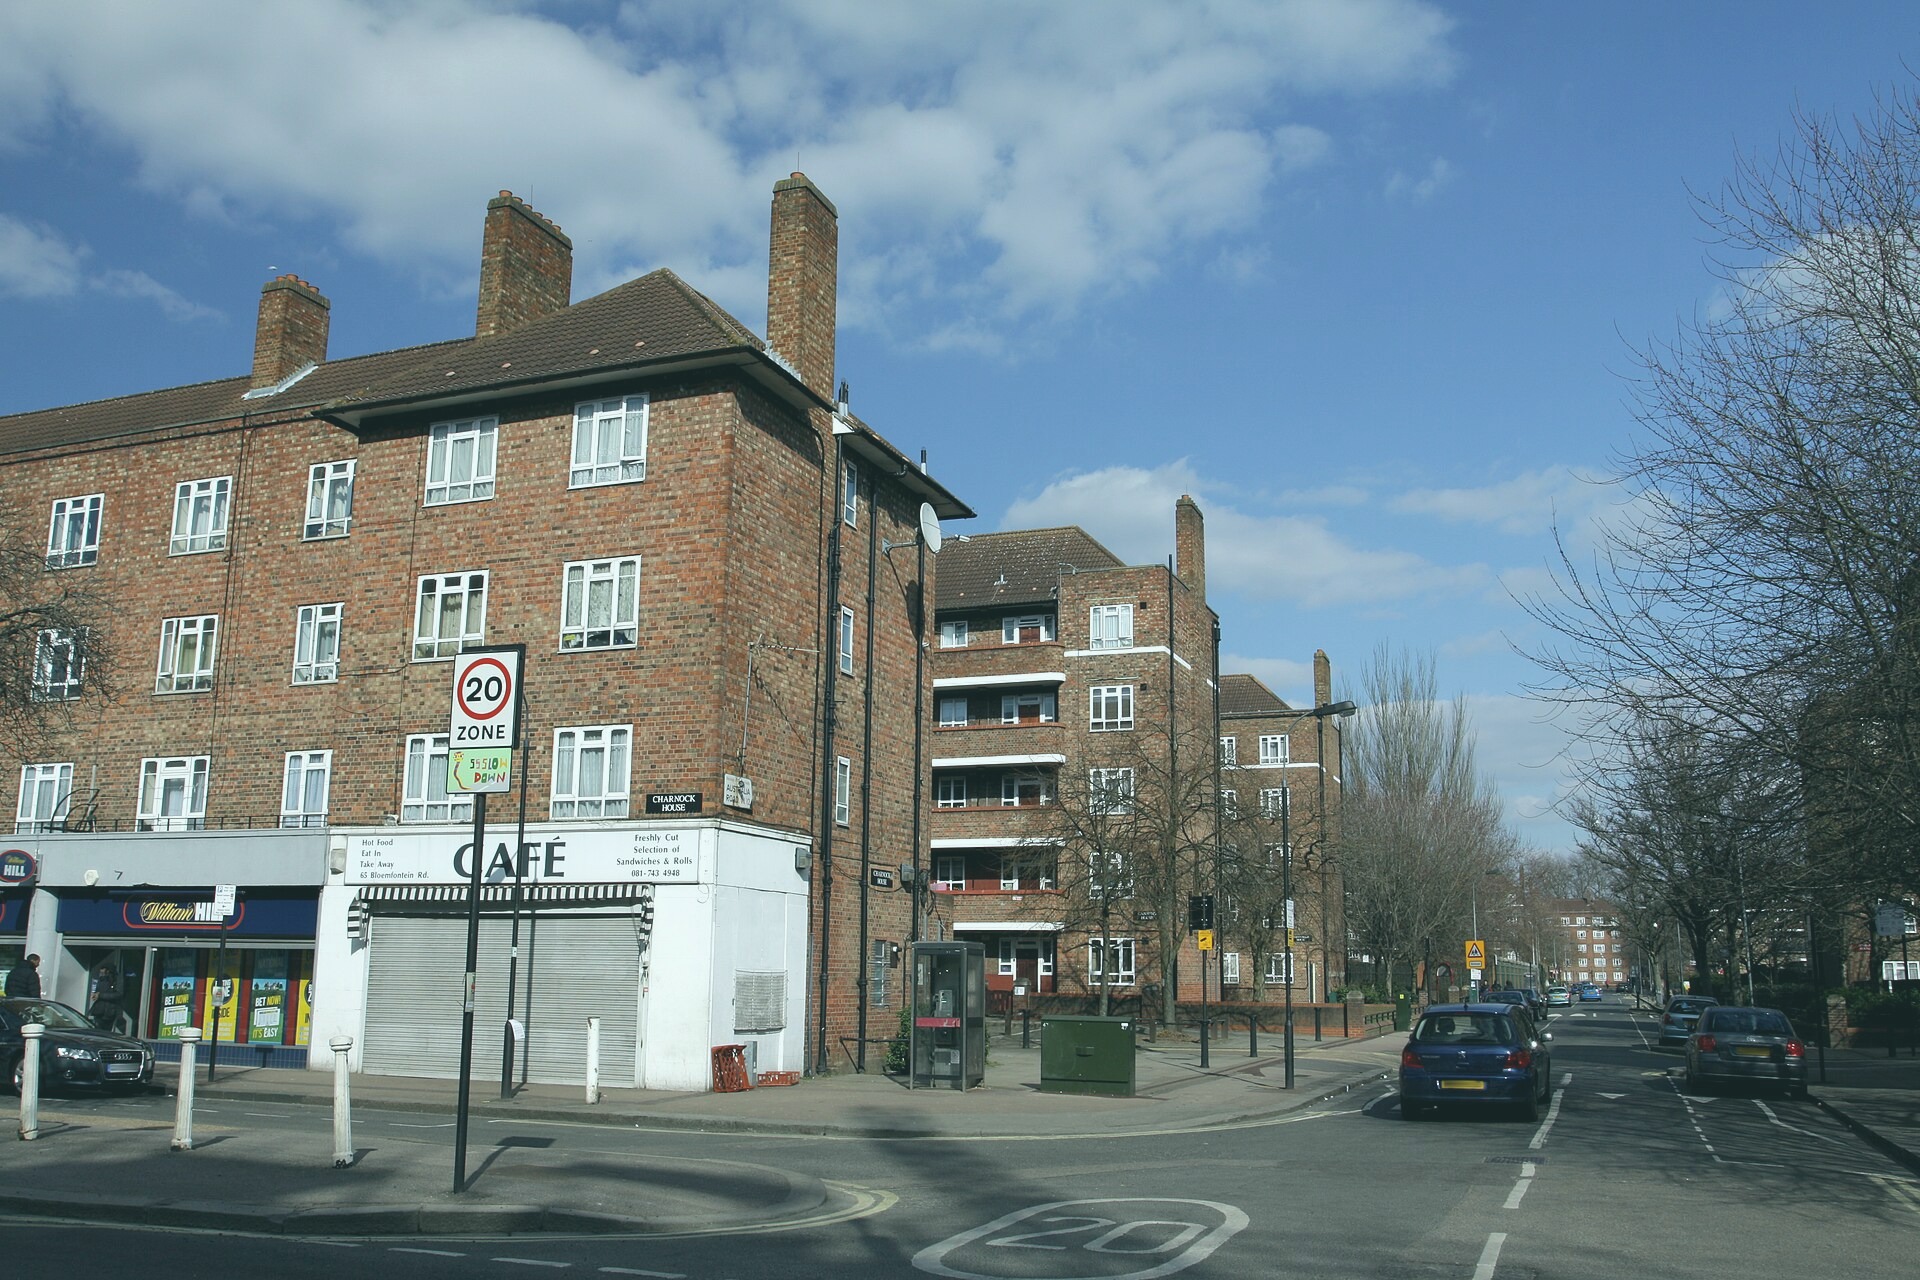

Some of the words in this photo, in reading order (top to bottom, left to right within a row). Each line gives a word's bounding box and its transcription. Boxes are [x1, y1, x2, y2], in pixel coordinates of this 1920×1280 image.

[466, 676, 503, 702] 20
[457, 724, 506, 741] ZONE
[470, 757, 508, 770] SSSLOW
[474, 772, 506, 783] DOWN
[652, 794, 696, 803] CHARNOCK
[661, 803, 686, 812] HOUSE
[377, 838, 393, 846] Food
[634, 833, 661, 843] Freshly
[665, 833, 679, 842] Cut
[361, 849, 371, 857] Eat
[374, 849, 381, 857] In
[634, 845, 668, 854] Selection
[672, 845, 680, 853] of
[453, 836, 566, 878] CAFÉ
[616, 857, 660, 865] Sandwiches
[663, 857, 669, 865] &
[673, 856, 692, 865] Rolls
[360, 860, 374, 868] Take
[377, 861, 394, 869] Away
[3, 864, 26, 877] HILL
[360, 871, 367, 879] 65
[370, 871, 414, 879] Bloemfontein
[662, 869, 680, 877] 4948
[141, 902, 194, 921] William
[164, 995, 175, 1006] BET
[175, 993, 189, 1004] NOW!
[255, 996, 266, 1007] BET
[266, 994, 281, 1006] NOW!
[263, 1027, 279, 1038] EASY
[985, 1216, 1209, 1254] 20
